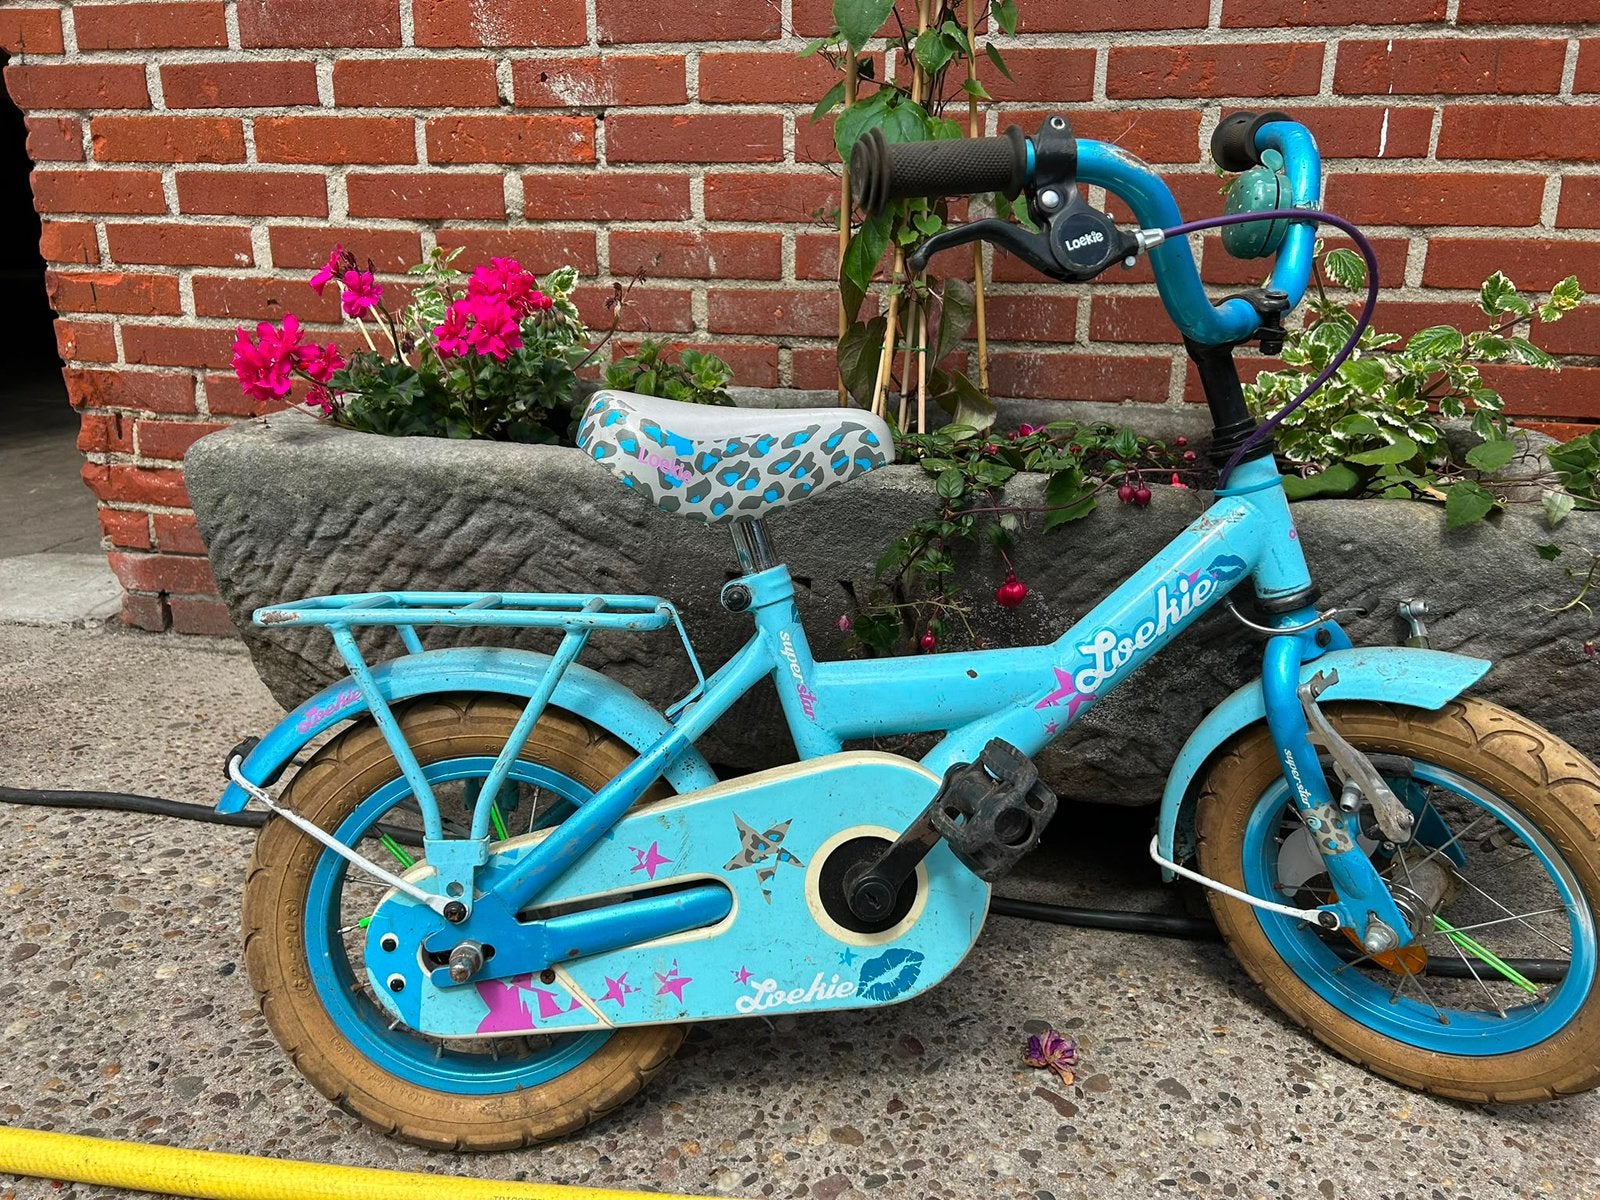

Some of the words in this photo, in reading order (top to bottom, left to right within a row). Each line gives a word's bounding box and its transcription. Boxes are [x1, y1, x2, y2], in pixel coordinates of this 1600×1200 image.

[1065, 231, 1104, 251] Loekie
[638, 446, 692, 484] Loekie
[1074, 576, 1219, 694] Loekie
[298, 688, 362, 733] Loekie
[736, 971, 857, 1013] Loekie
